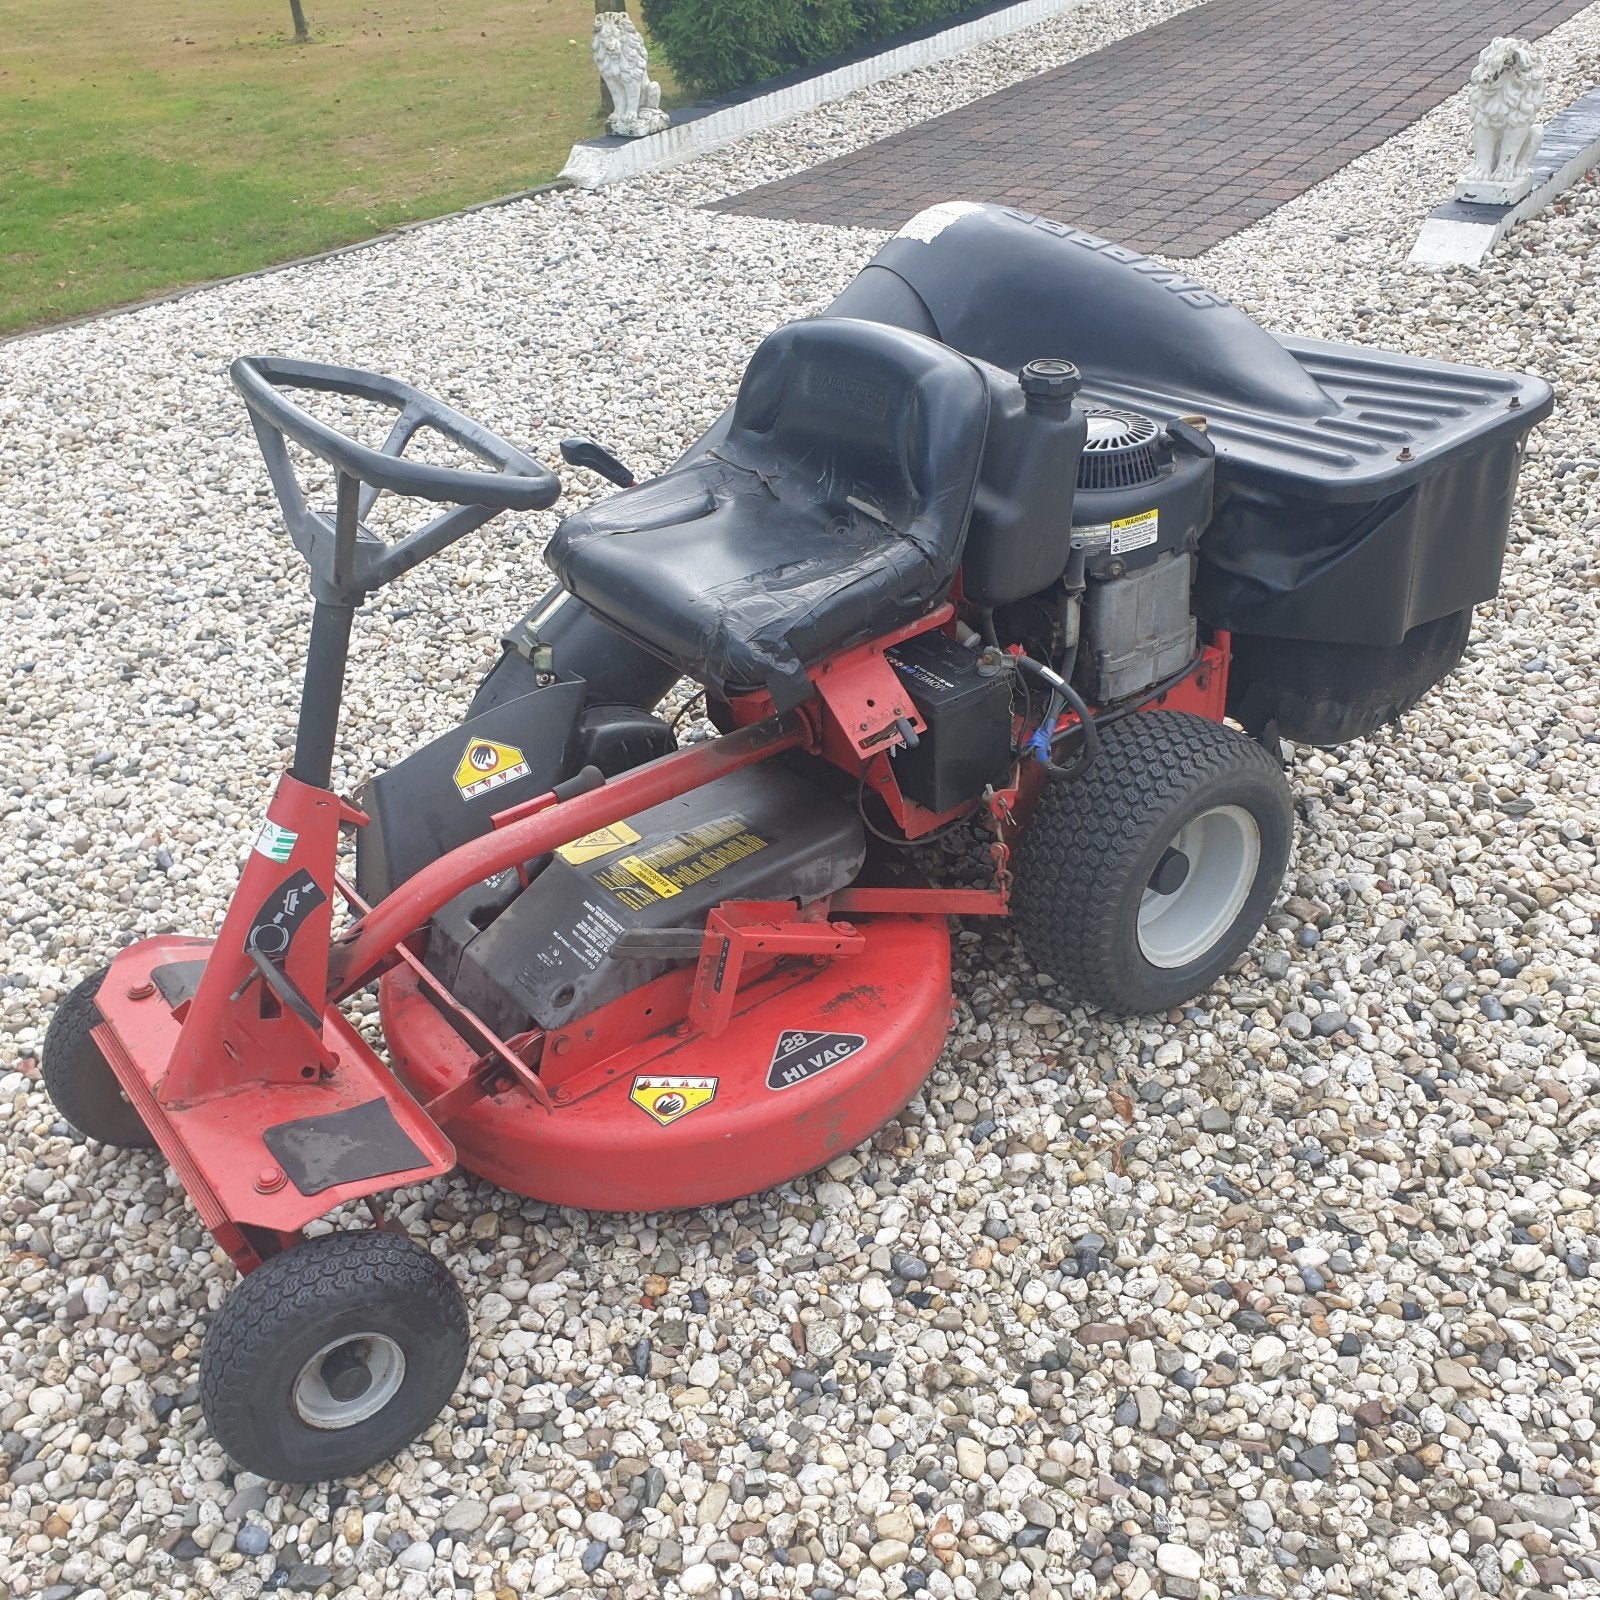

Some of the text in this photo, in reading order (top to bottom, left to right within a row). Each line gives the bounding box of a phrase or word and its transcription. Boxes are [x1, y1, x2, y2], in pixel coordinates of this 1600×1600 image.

[1002, 207, 1231, 309] SNAPPER
[1124, 513, 1152, 526] WARNING
[912, 671, 948, 692] MOWER
[781, 1032, 807, 1053] 28
[781, 1042, 851, 1083] HI VAC
